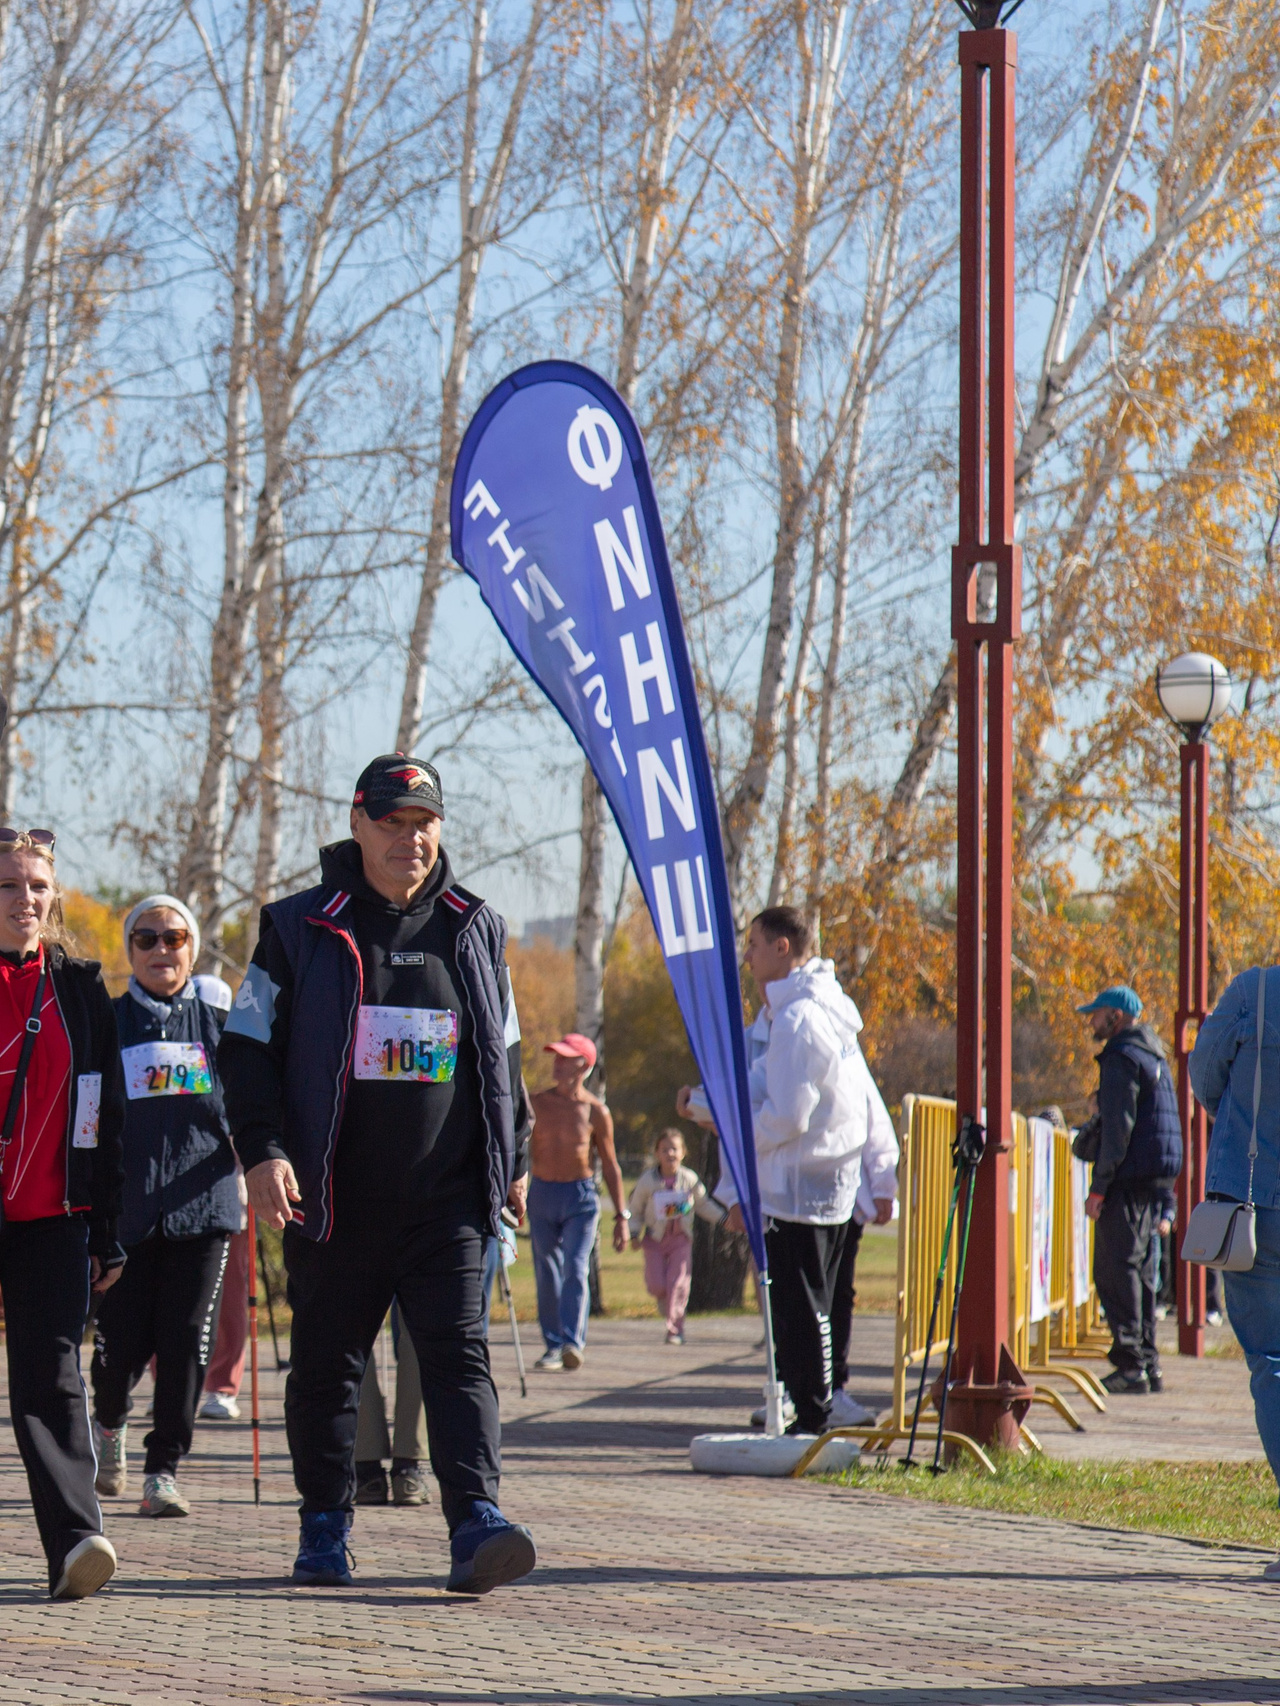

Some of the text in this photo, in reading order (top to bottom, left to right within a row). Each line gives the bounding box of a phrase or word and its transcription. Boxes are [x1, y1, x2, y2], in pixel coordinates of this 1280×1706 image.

[383, 1038, 433, 1073] 105
[144, 1064, 188, 1091] 279
[199, 1316, 211, 1365] FRESH
